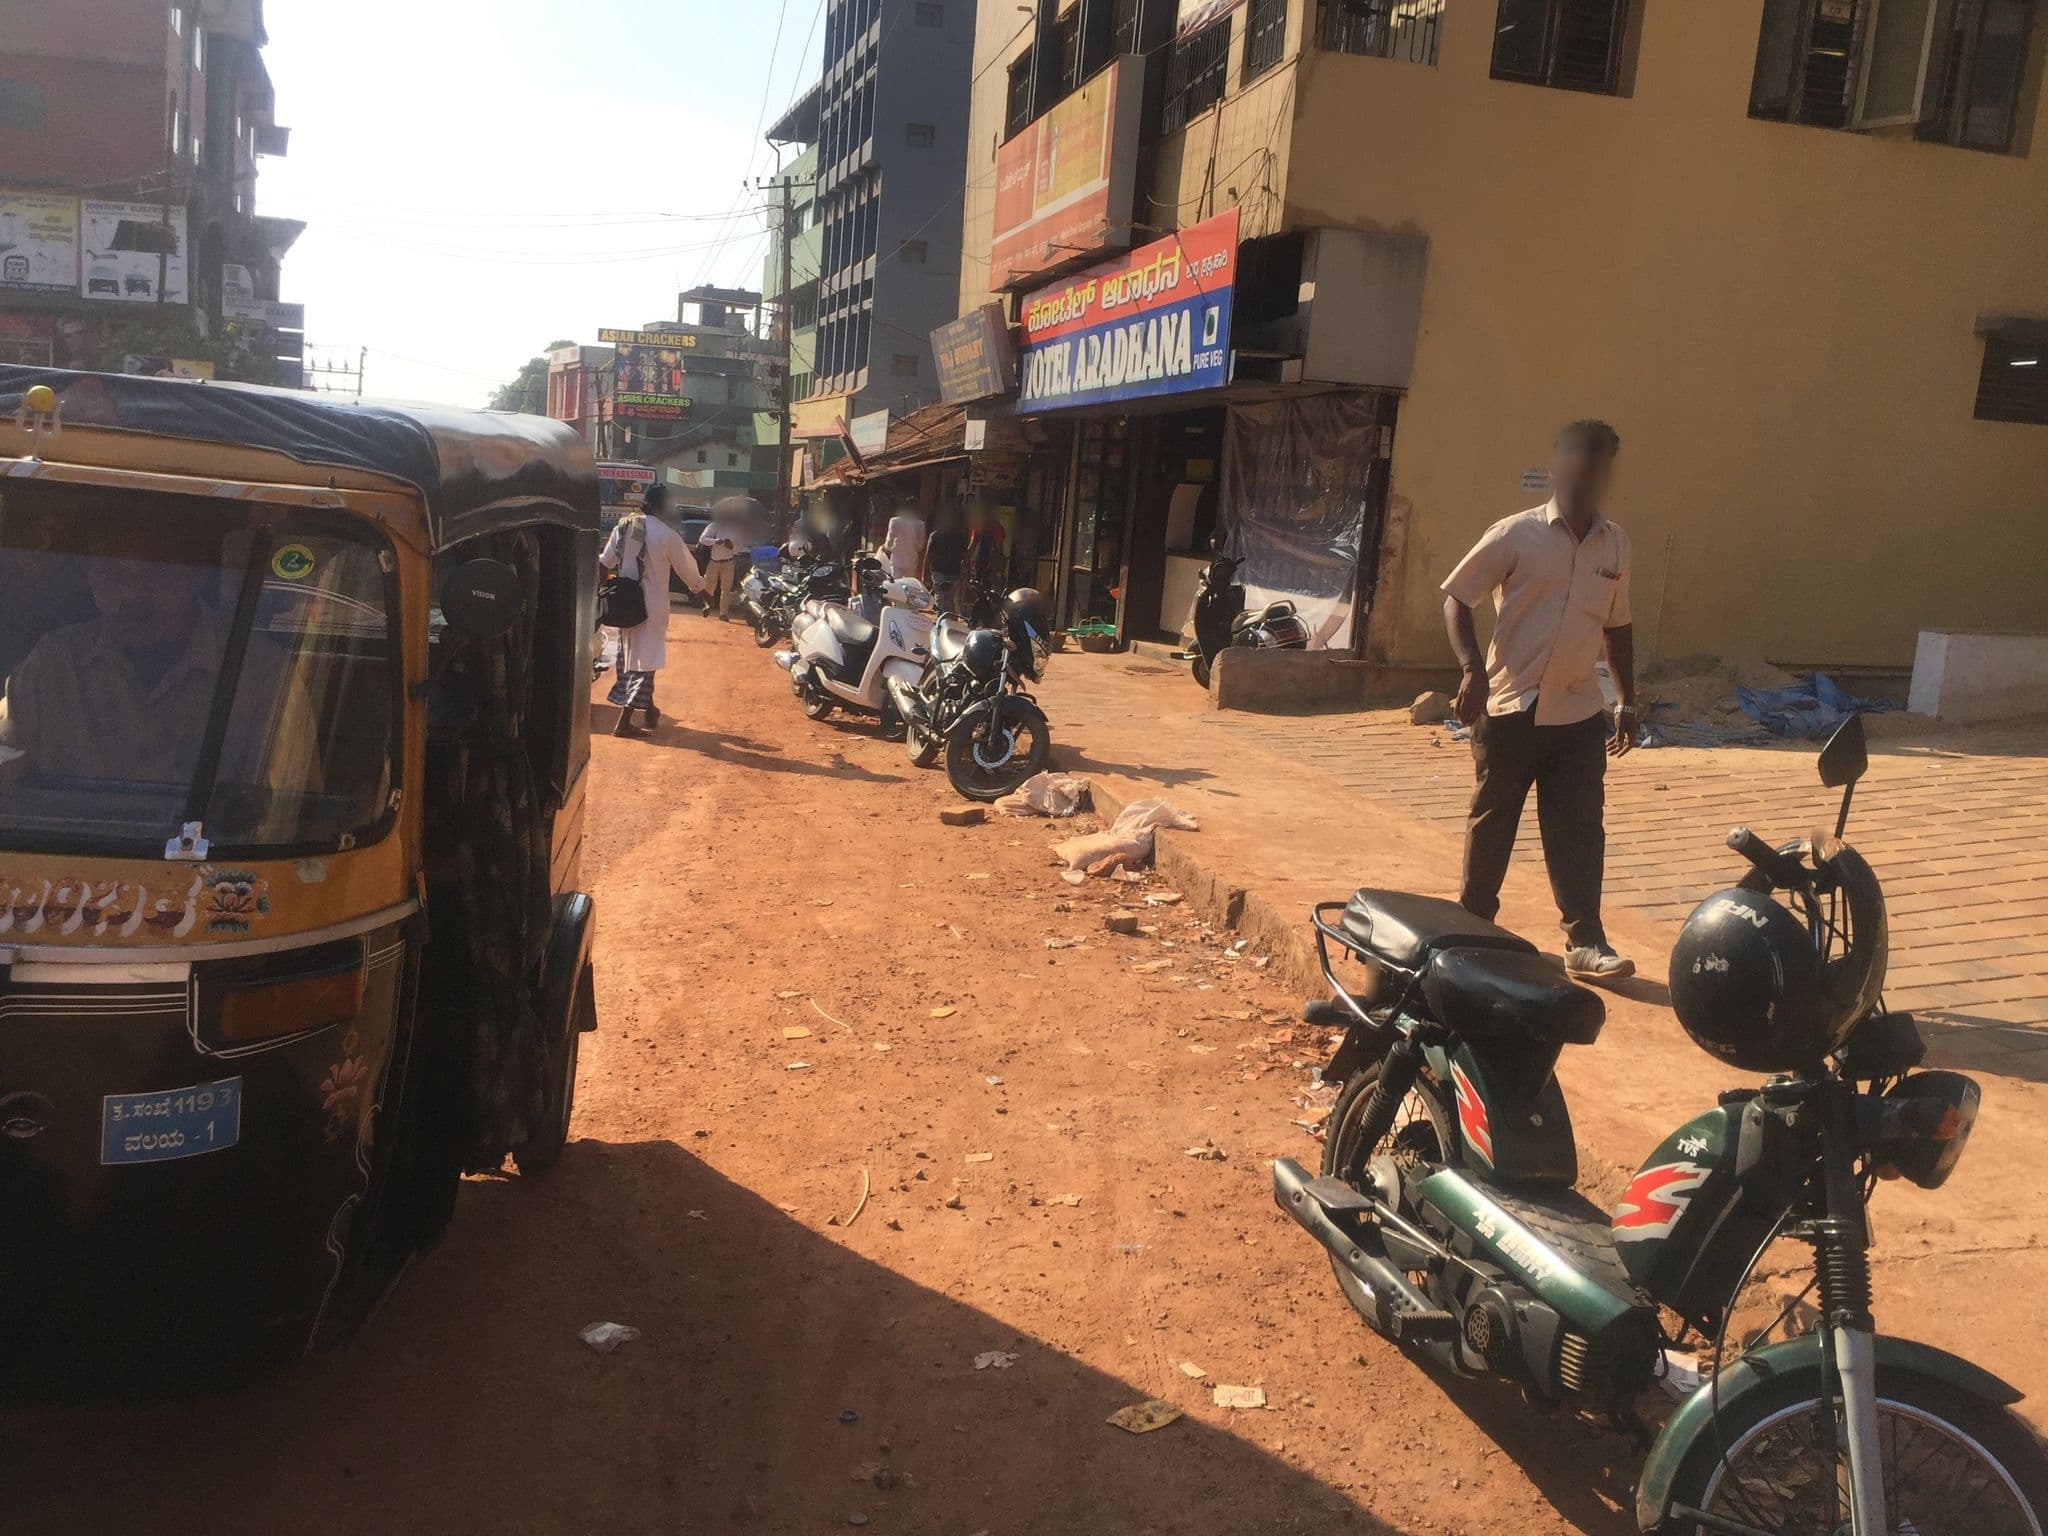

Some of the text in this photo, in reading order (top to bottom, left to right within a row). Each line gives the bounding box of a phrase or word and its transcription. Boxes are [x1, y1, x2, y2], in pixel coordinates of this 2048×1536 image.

[602, 329, 696, 347] ASIAN CRACKERS
[1023, 340, 1071, 400] HOTEL
[1074, 310, 1191, 392] ARADHANA
[1193, 349, 1223, 370] PURE VEG
[617, 394, 690, 407] ASIAN CRACKERS
[207, 1121, 215, 1141] 1
[1677, 1138, 1700, 1157] TVS
